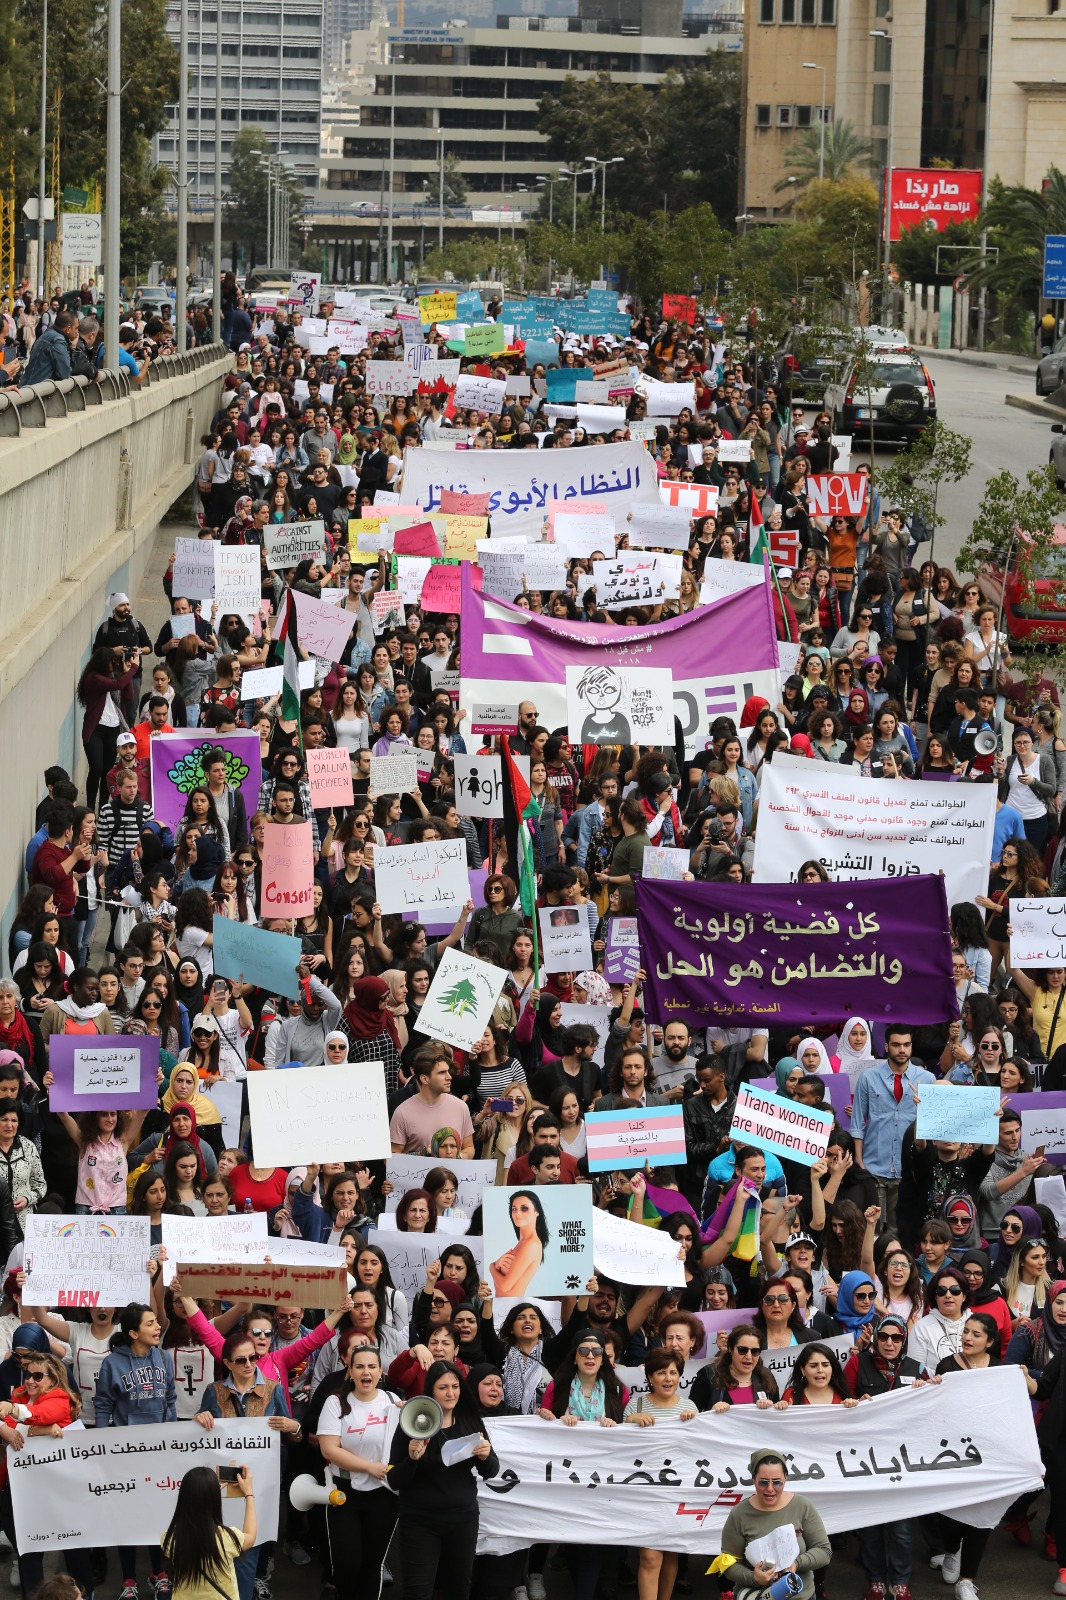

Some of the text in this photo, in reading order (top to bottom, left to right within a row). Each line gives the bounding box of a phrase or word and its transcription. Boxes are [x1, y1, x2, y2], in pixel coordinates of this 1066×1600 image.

[931, 179, 959, 199] صار
[893, 199, 970, 213] نزاهة مش فساد
[334, 326, 353, 335] Gender
[368, 381, 409, 392] GLASS
[563, 465, 641, 501] النظام
[488, 476, 558, 520] الأبوي
[275, 525, 312, 538] AGAINST
[291, 536, 303, 544] ALL
[271, 540, 321, 554] AUTHORITIES
[220, 552, 258, 564] IF YOUR
[269, 554, 301, 564] except my
[604, 575, 640, 589] ثوري
[498, 586, 517, 597] SHIT
[237, 597, 261, 608] BOTHER
[618, 657, 640, 665] ٢٠١٨
[631, 712, 656, 725] ROSE
[311, 749, 346, 761] WOMEN
[802, 790, 829, 801] الأسري
[831, 791, 855, 802] العنف
[857, 796, 881, 805] قانون
[883, 797, 907, 807] تعديل
[909, 799, 929, 810] تمنع
[931, 799, 966, 810] الطوائف
[767, 802, 985, 829] الطوائف تمنع وجود قانون مدني موحد للأحوال الشخصية
[783, 821, 800, 832] سنة
[820, 828, 844, 838] للزواج
[846, 828, 866, 840] أدنى
[866, 833, 882, 842] سن
[884, 833, 908, 842] تحديد
[908, 834, 928, 845] تمنع
[930, 836, 965, 847] الطوائف
[818, 853, 873, 871] التشريع
[673, 906, 881, 943] كل قضية أولوية
[655, 950, 903, 987] والتضامن هو الحل
[79, 1053, 99, 1062] حماية
[100, 1053, 118, 1063] قانون
[101, 1066, 125, 1074] الطفلات
[85, 1077, 129, 1088] التزويج المبكر
[266, 1086, 382, 1112] IN SOLIDARITY
[743, 1088, 825, 1134] Trans women
[276, 1113, 381, 1133] WITH THE WOMEN
[628, 1121, 646, 1131] كلنا
[732, 1115, 826, 1159] are women too
[1029, 1127, 1058, 1137] لعبة مش
[617, 1132, 659, 1144] بالنسوية
[33, 1220, 148, 1238] WE ARE THE
[561, 1220, 583, 1229] WHAT
[558, 1229, 586, 1238] SHOCKS
[565, 1236, 579, 1245] YOU
[560, 1244, 585, 1253] MORE?
[177, 1265, 243, 1279] للاغتصاب
[244, 1268, 288, 1280] الوحيد
[57, 1290, 101, 1307] BURN
[215, 1285, 292, 1301] هو المغتصب
[13, 1436, 272, 1470] الثقافة الذكورية اسقطت الكوتا النسائية
[692, 1435, 983, 1489] قضايانا متددة
[88, 1477, 136, 1497] ترجعيها
[57, 1530, 82, 1541] مشروع
